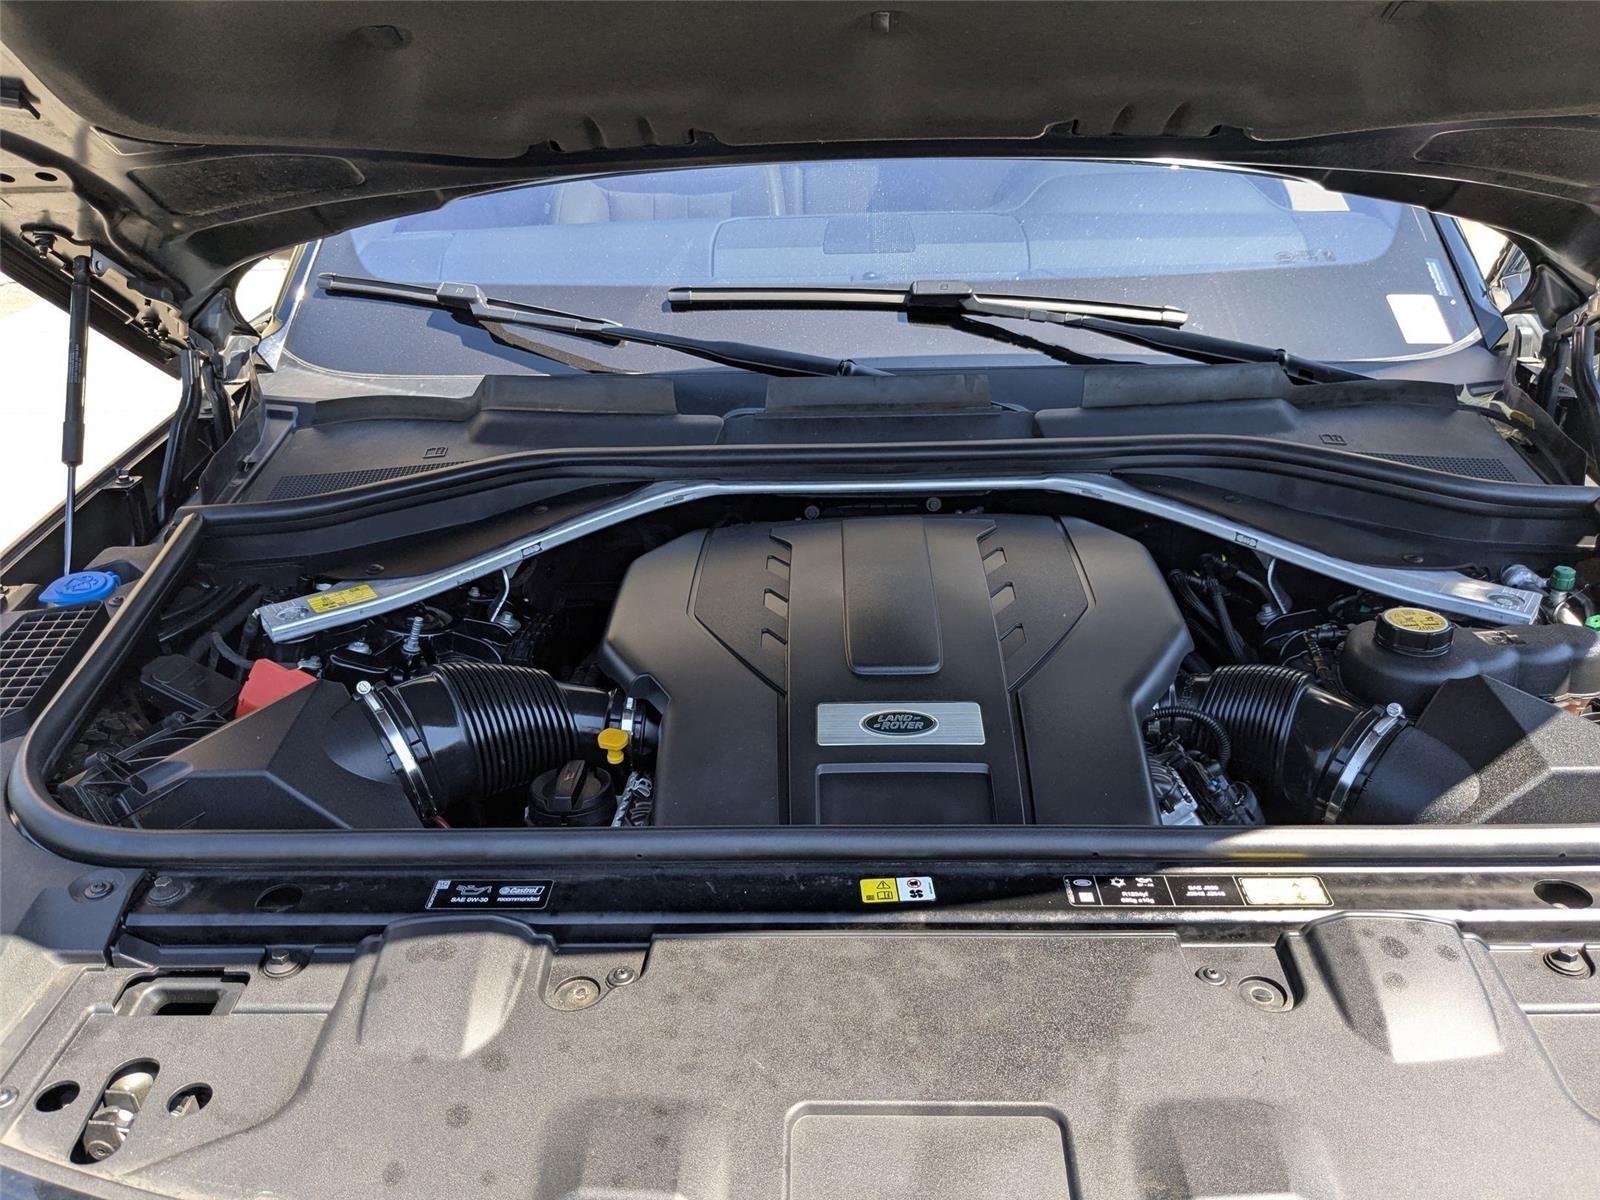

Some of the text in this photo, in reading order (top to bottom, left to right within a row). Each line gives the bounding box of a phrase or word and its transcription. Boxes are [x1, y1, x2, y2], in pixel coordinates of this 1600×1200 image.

[877, 714, 914, 722] LAND
[880, 721, 924, 730] ROVER
[510, 886, 539, 894] Castrol
